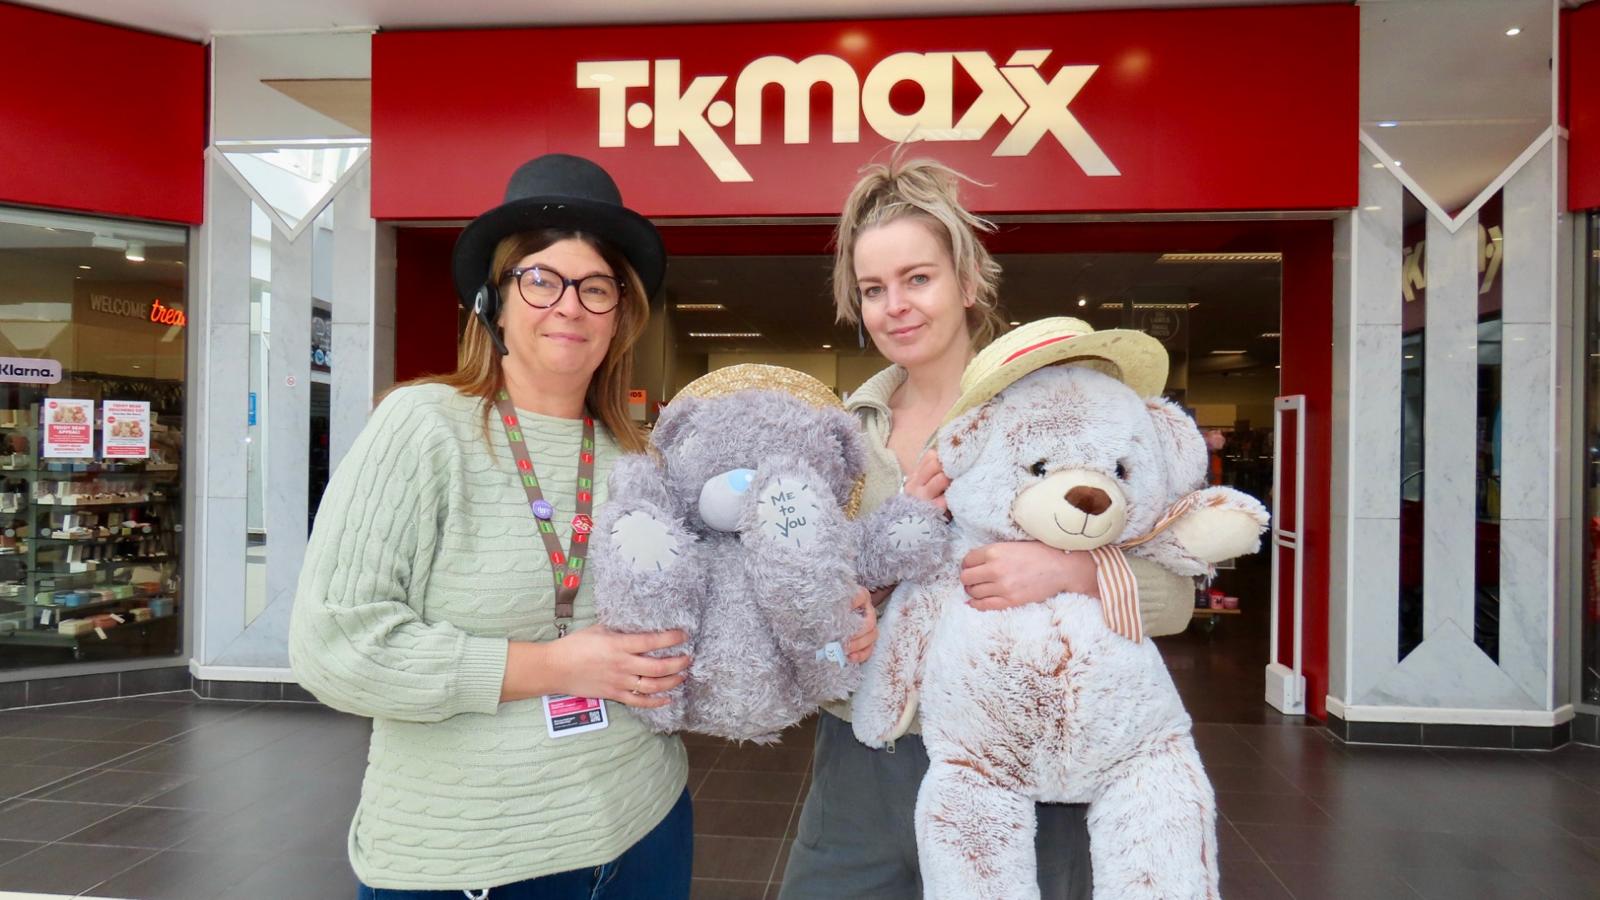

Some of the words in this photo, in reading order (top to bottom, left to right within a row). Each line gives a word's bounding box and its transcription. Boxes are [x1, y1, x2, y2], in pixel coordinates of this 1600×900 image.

[90, 293, 147, 319] WELCOME
[0, 364, 54, 377] Klarna.
[770, 491, 796, 506] ME
